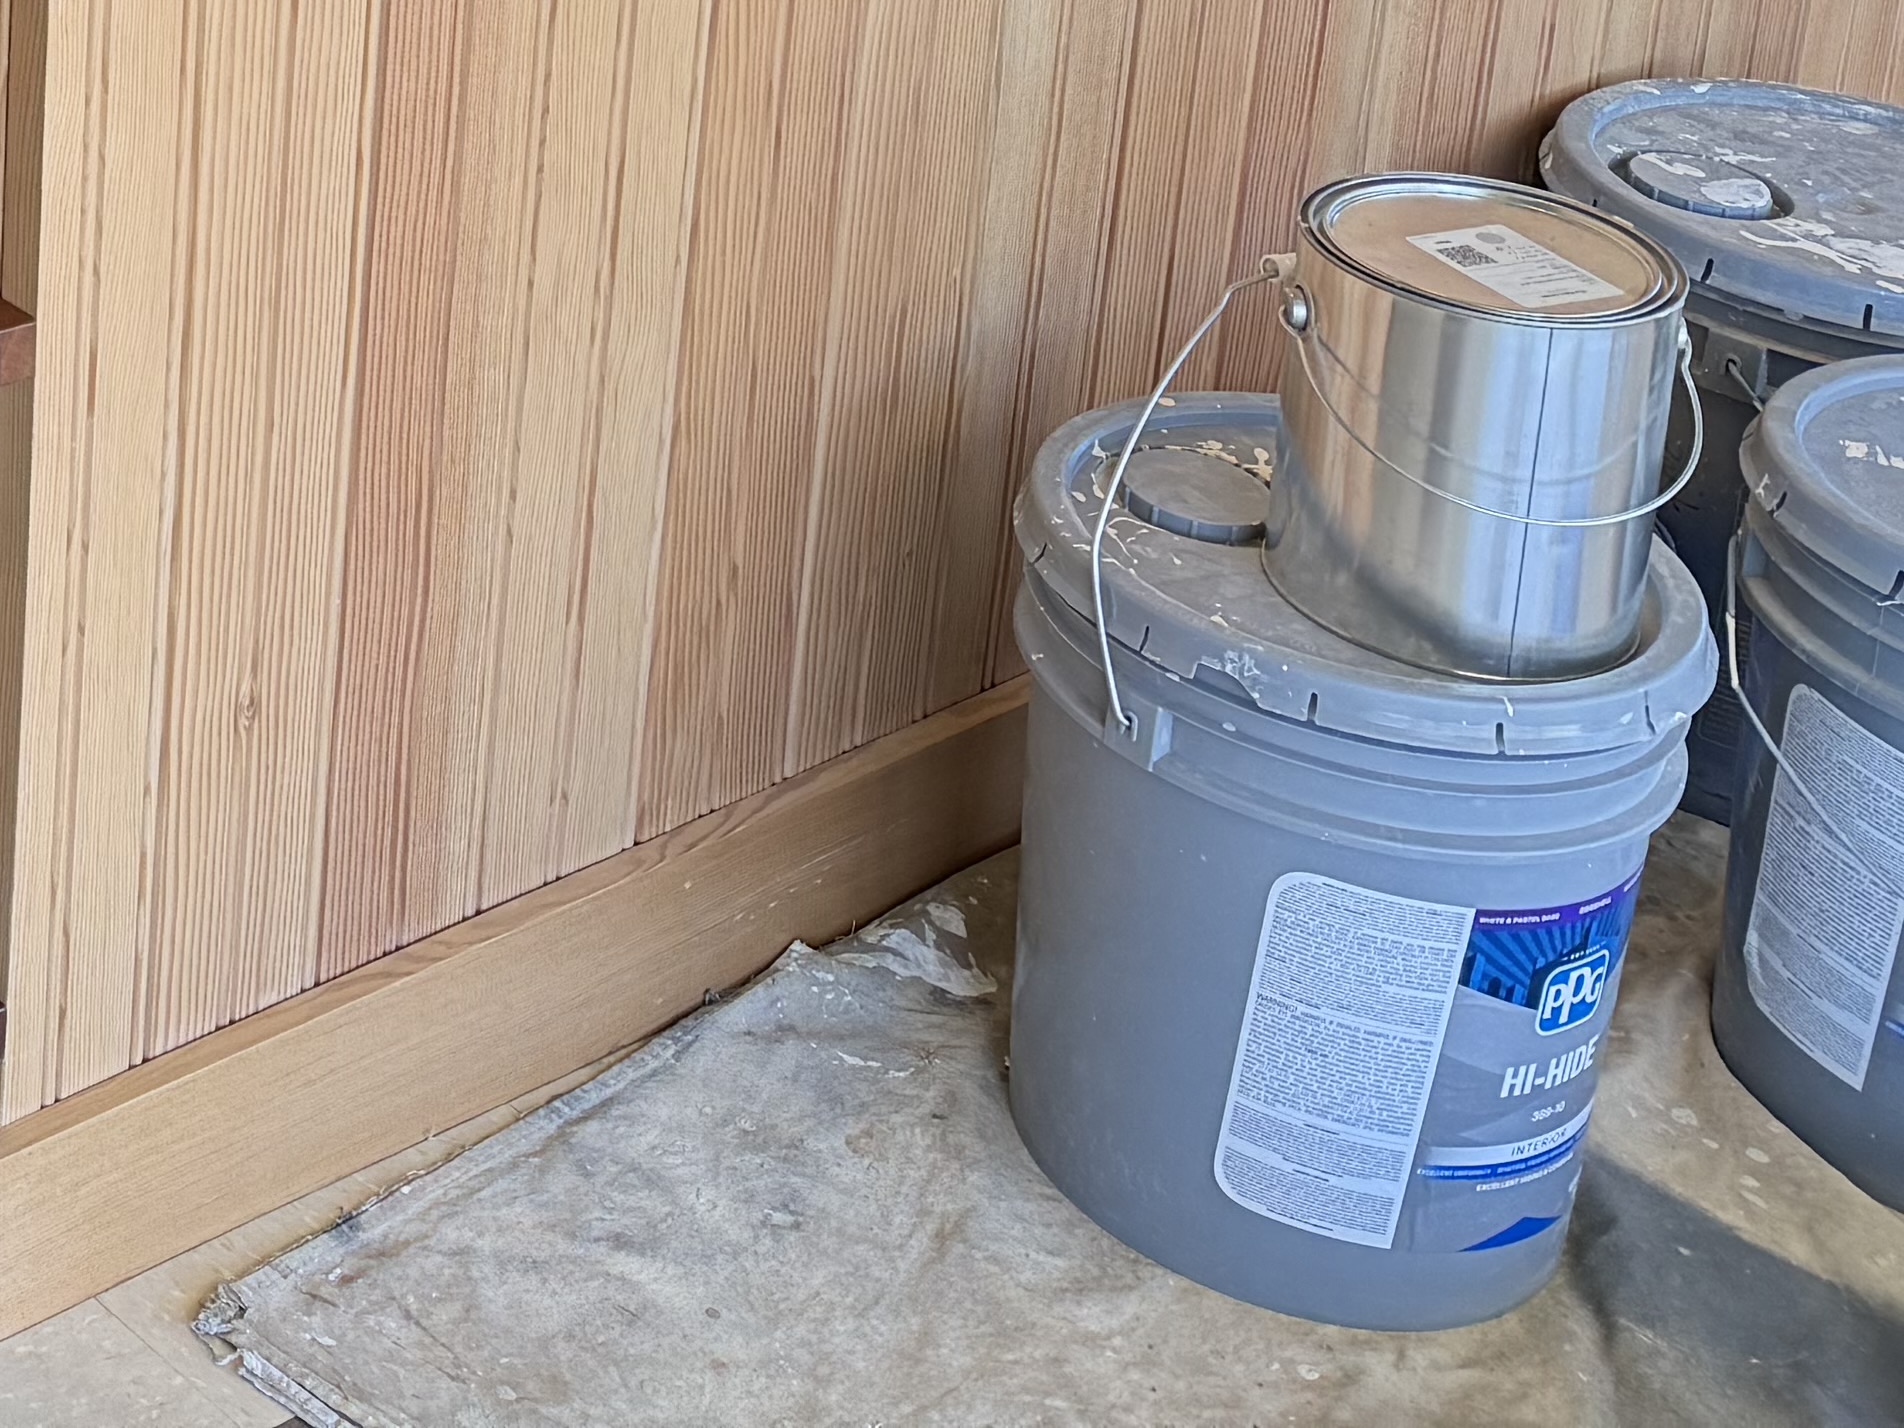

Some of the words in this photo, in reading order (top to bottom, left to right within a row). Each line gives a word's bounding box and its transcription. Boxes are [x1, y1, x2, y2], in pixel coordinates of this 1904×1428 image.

[1542, 966, 1605, 1025] PPG
[1500, 1034, 1599, 1098] HI-HIDE
[1511, 1128, 1568, 1157] INTERIOR
